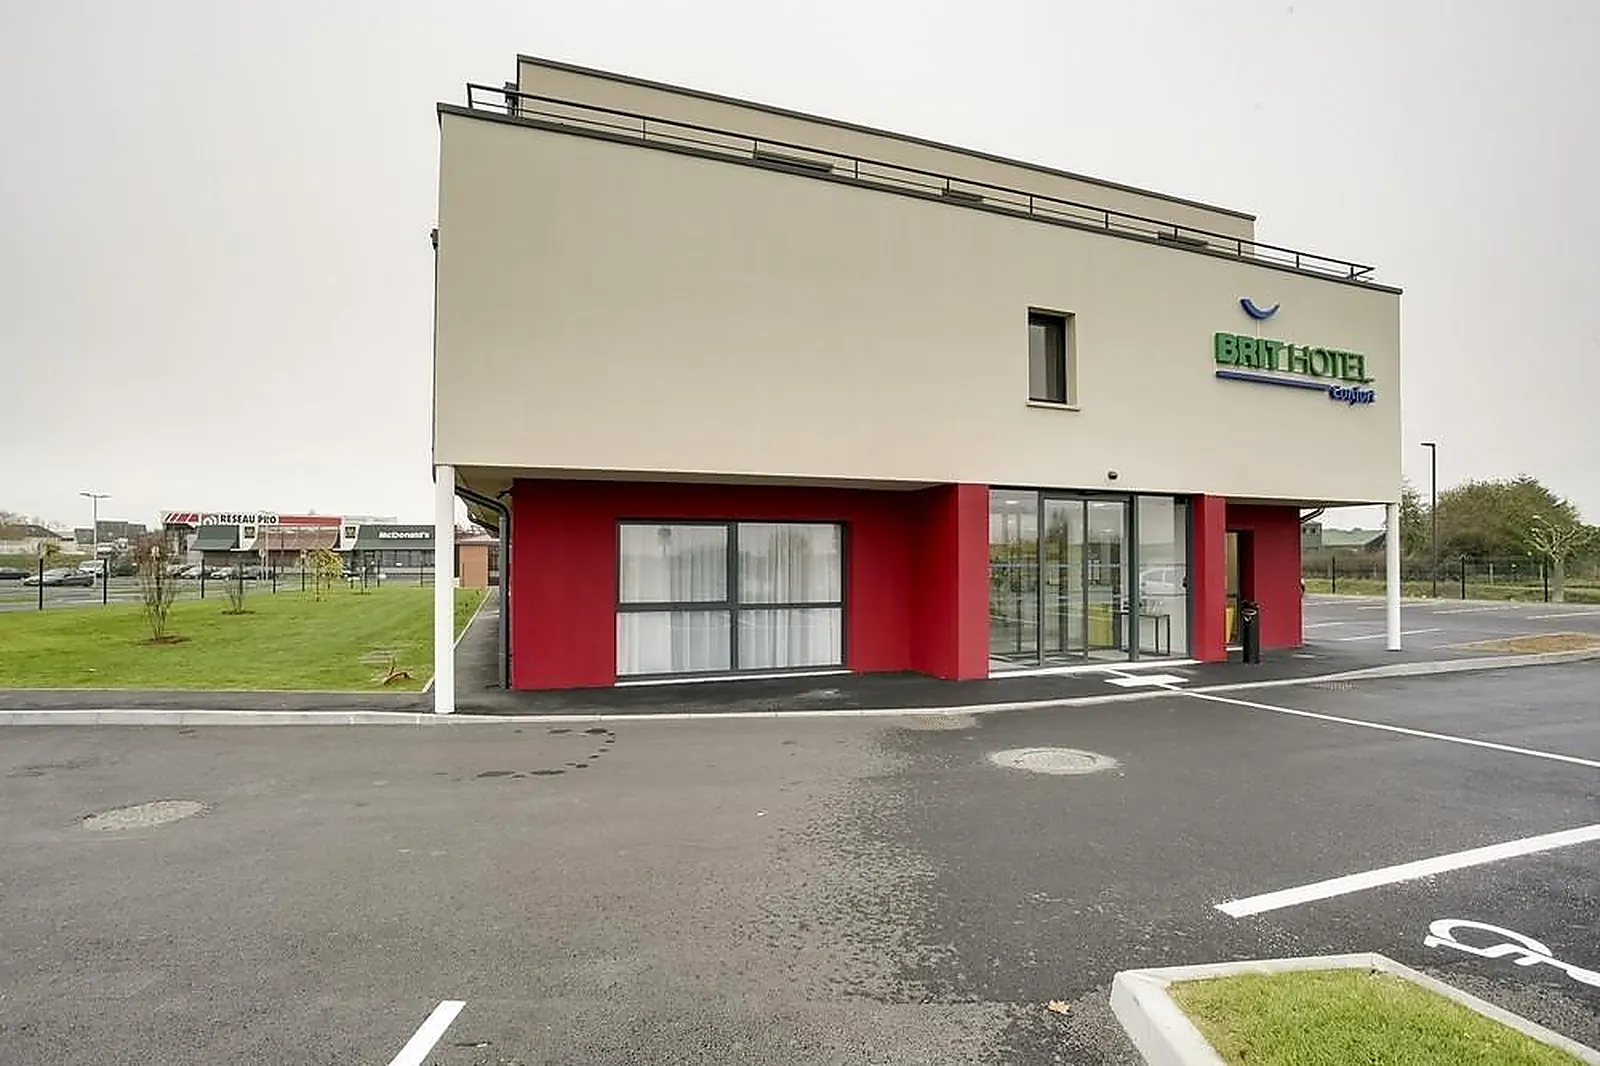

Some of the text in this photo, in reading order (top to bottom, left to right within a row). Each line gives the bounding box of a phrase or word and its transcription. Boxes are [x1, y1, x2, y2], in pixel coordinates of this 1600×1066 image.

[1214, 332, 1375, 383] BRIT HOTEL
[220, 514, 277, 524] RESEAU PRO
[378, 531, 430, 539] McDonald's
